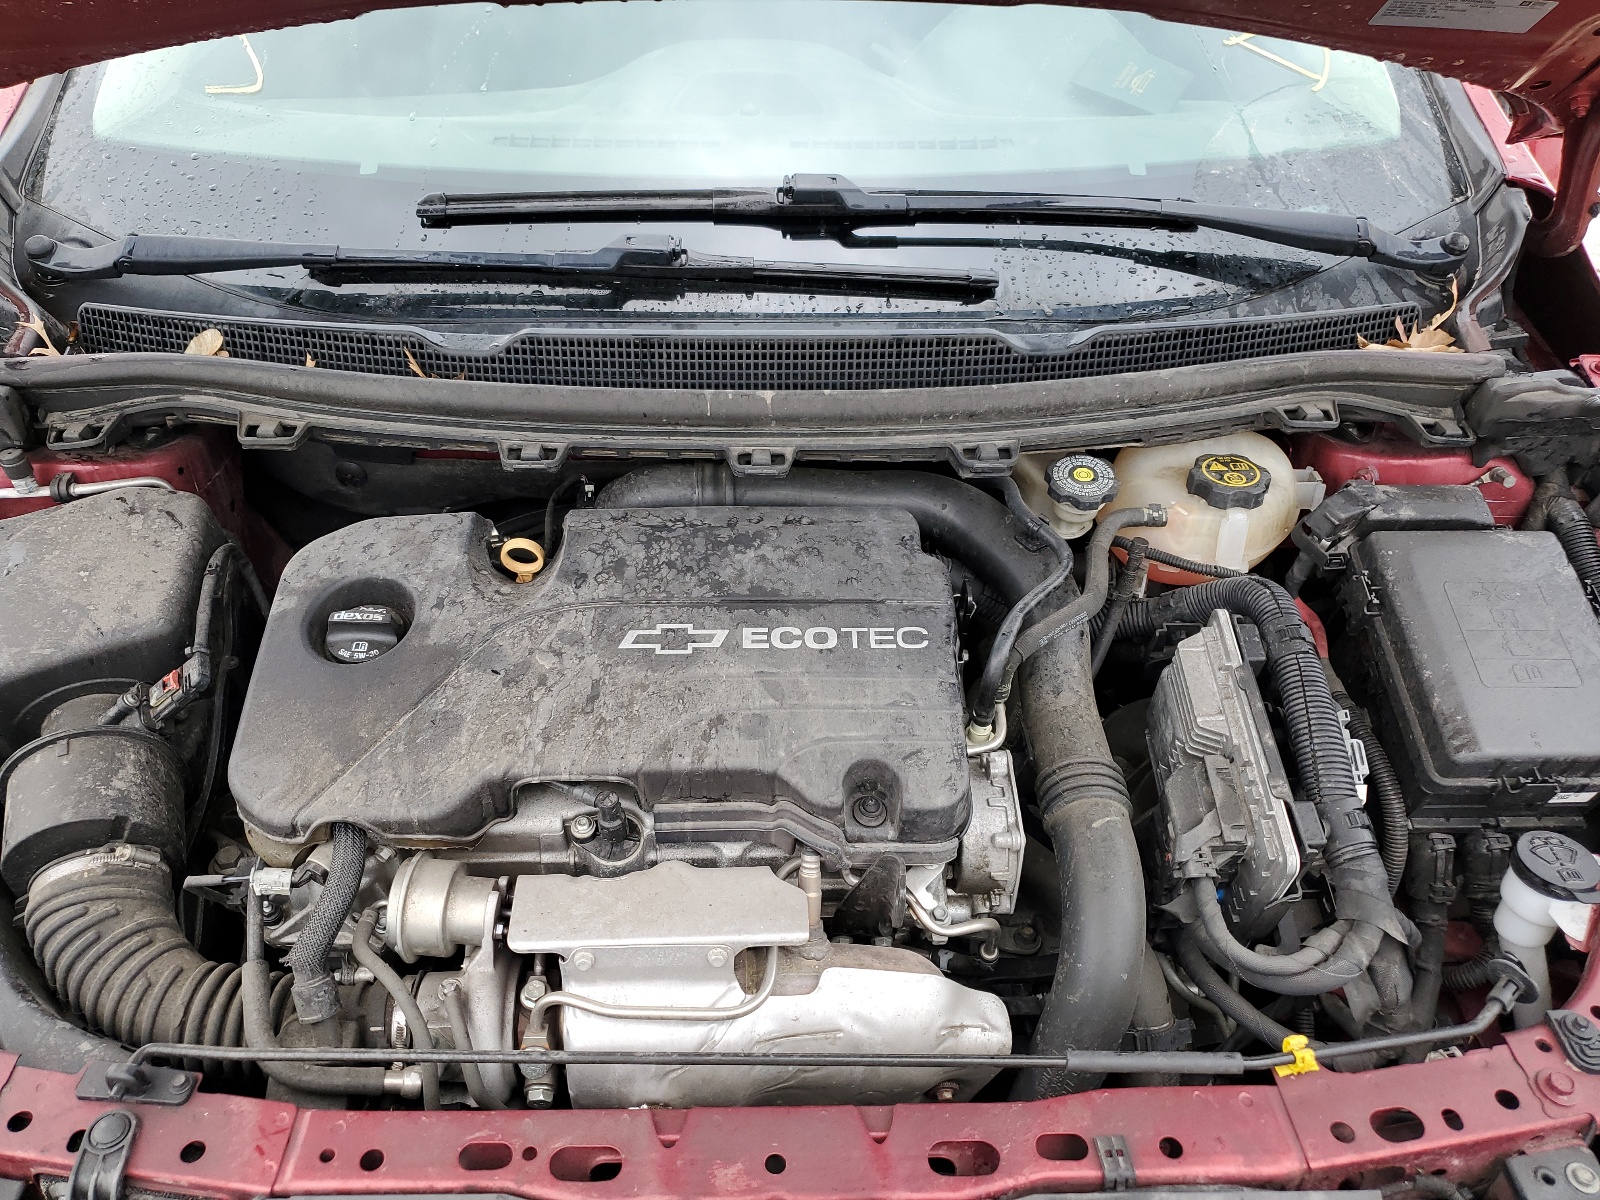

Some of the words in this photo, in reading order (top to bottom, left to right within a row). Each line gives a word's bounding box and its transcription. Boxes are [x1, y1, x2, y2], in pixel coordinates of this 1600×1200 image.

[333, 611, 386, 621] dexos
[742, 626, 929, 649] ECOTEC
[338, 648, 352, 658] SAE
[353, 649, 380, 659] 5W-30
